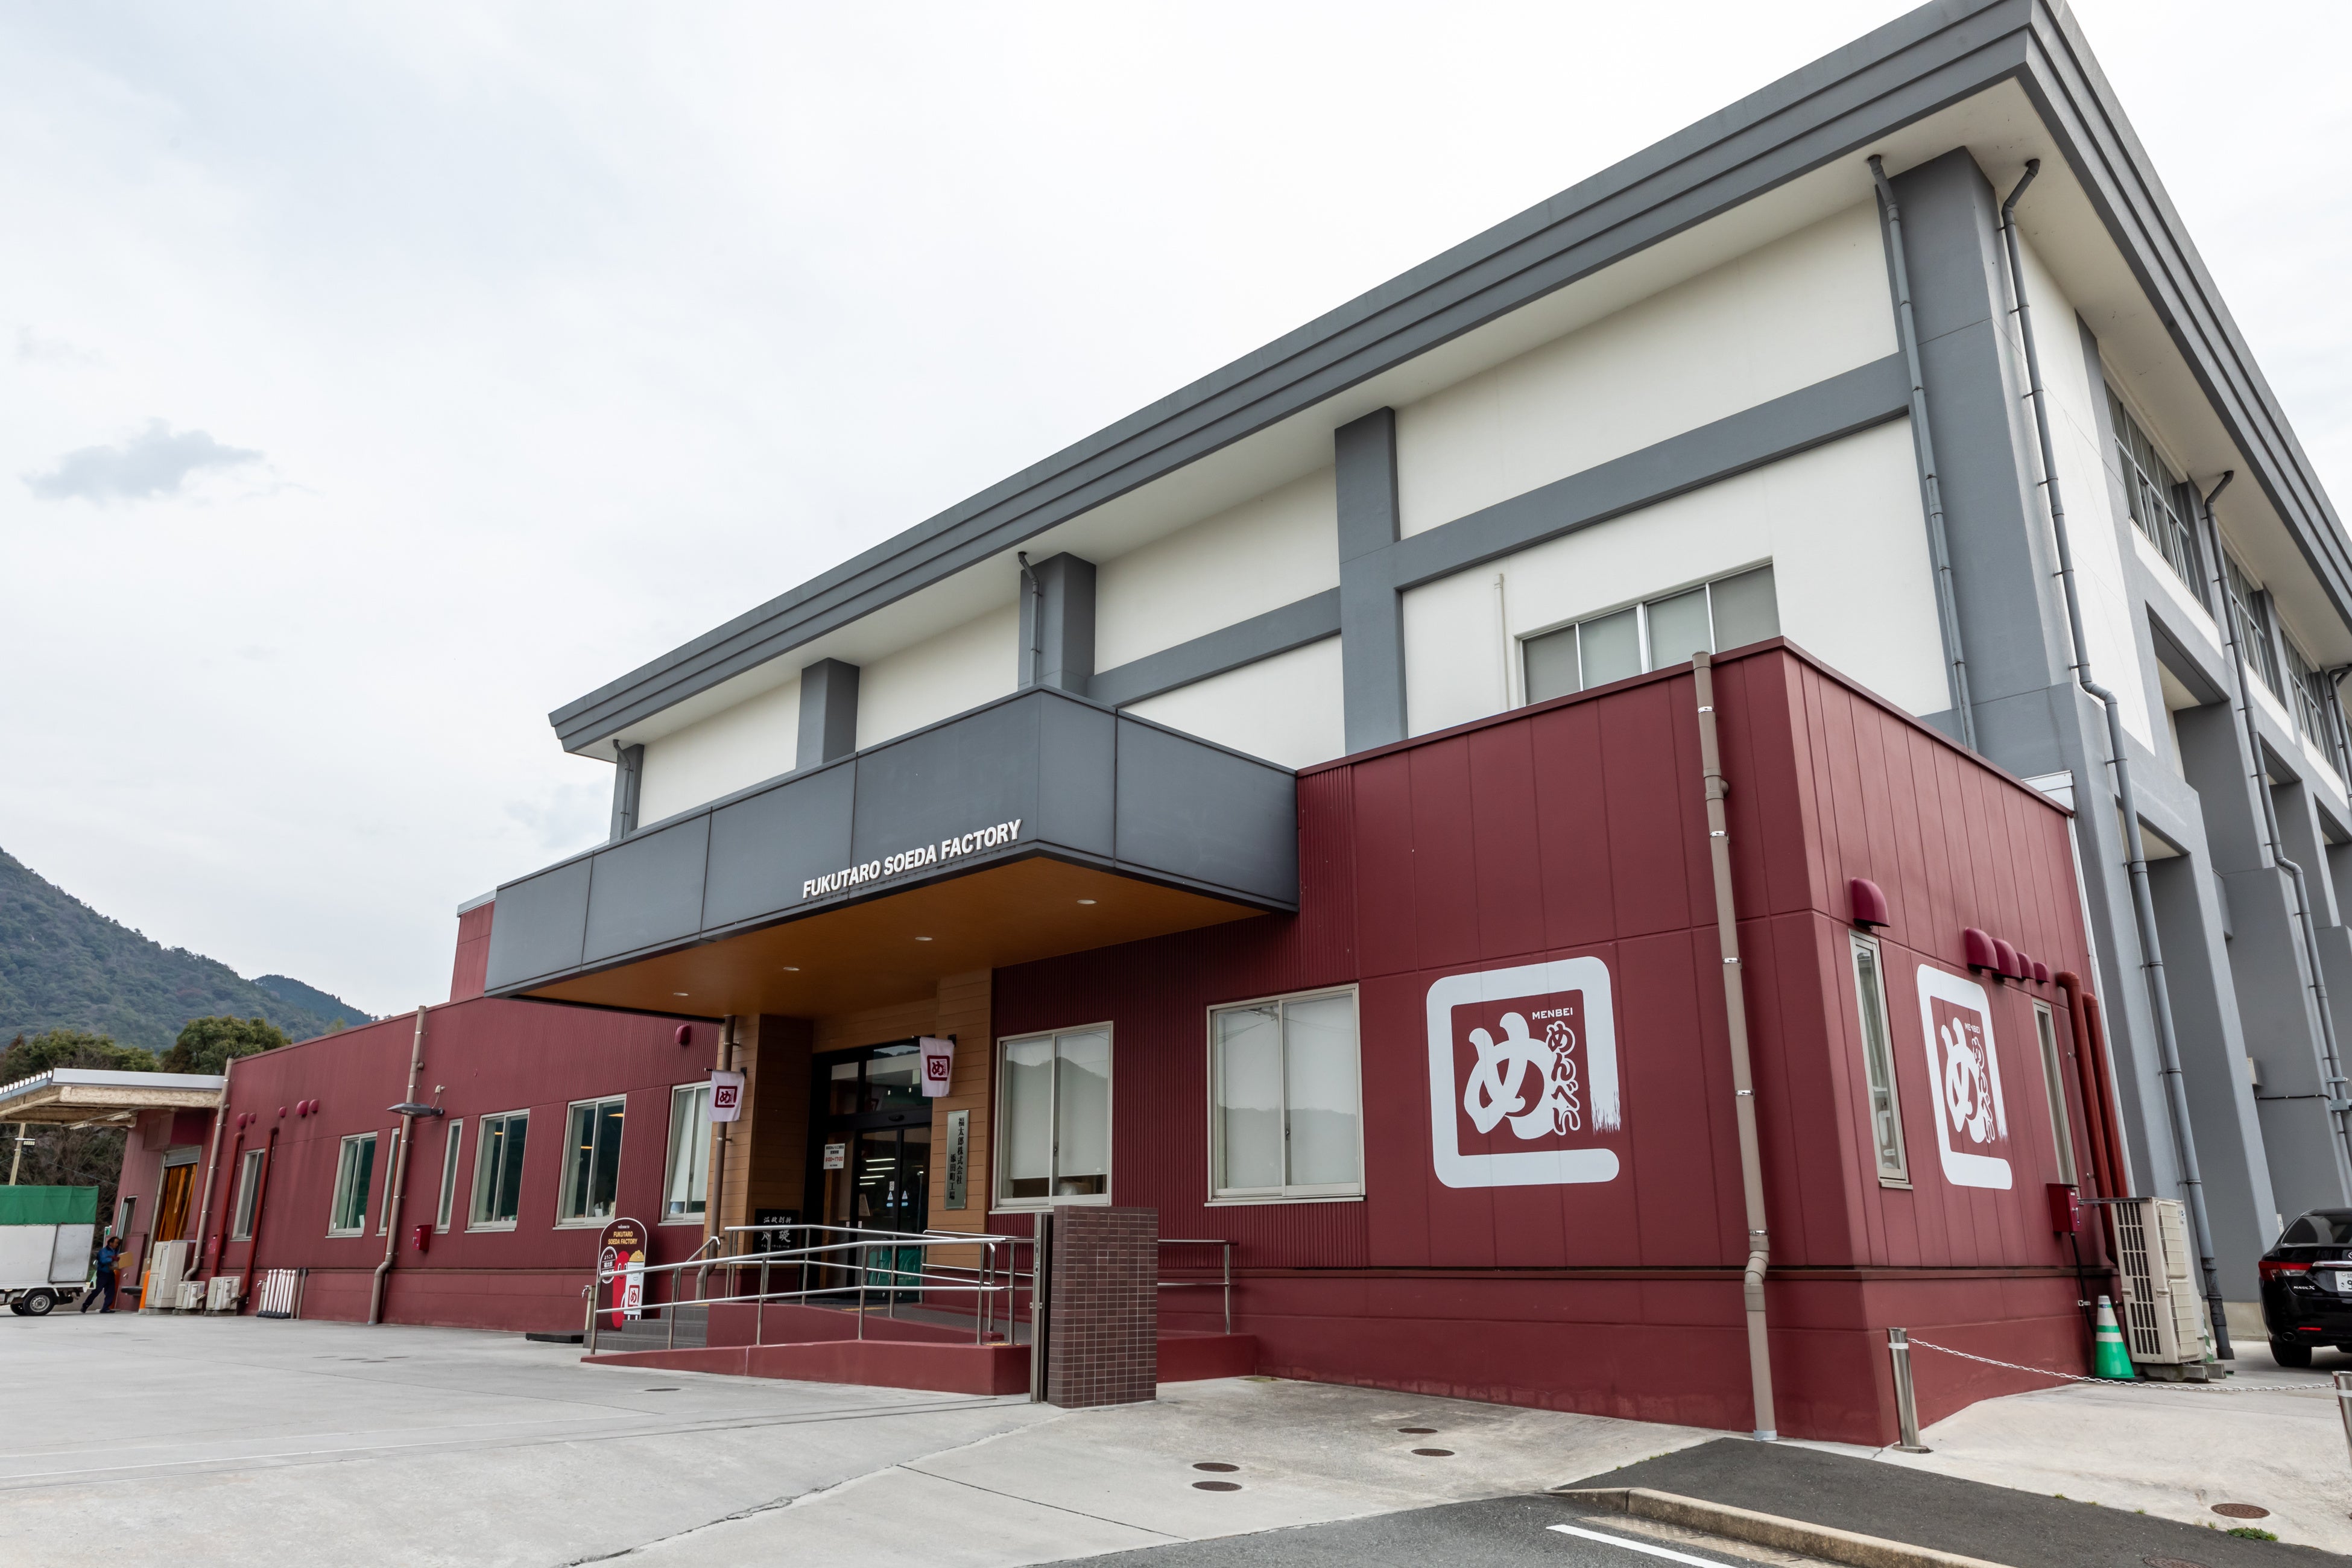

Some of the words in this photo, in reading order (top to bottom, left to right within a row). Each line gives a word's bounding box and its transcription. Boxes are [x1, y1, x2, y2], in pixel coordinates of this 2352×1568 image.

[803, 860, 880, 899] FUKUTARO
[884, 844, 937, 876] SOEDA
[941, 818, 1022, 860] FACTORY
[1532, 1007, 1573, 1020] MENBEI
[1964, 1022, 1981, 1034] MENBEI
[719, 1090, 731, 1104] め
[932, 1061, 944, 1076] め
[1464, 1012, 1554, 1140] め
[1546, 1020, 1581, 1136] めんべい
[1941, 1017, 1986, 1143] め
[1971, 1035, 1996, 1143] めんべい
[956, 1117, 965, 1184] 福太郎株式会社
